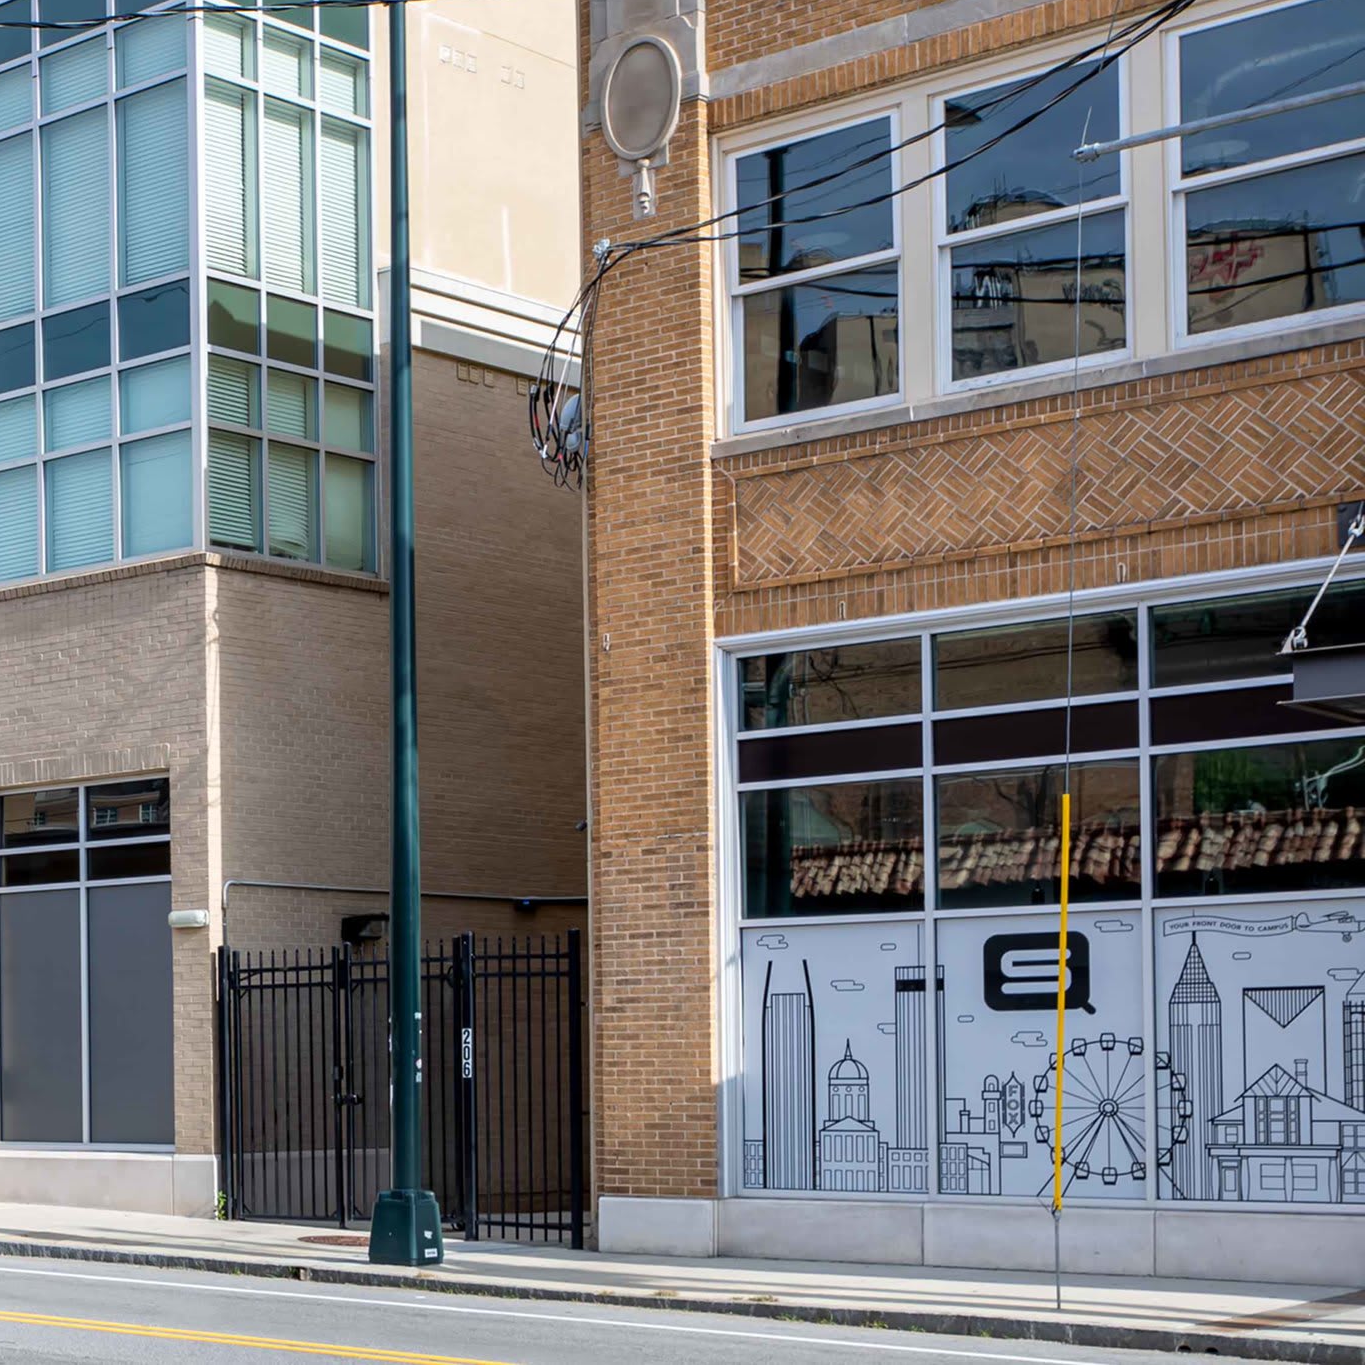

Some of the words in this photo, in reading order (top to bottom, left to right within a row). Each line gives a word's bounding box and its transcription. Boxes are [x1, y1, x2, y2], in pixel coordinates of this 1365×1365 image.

[1169, 921, 1190, 931] YOUR
[1192, 920, 1218, 928] FRONT
[1219, 921, 1242, 931] DOOR
[1244, 922, 1255, 932] TO
[1257, 922, 1290, 932] CAMPUS
[463, 1029, 471, 1077] 206
[1008, 1084, 1019, 1125] FOX
